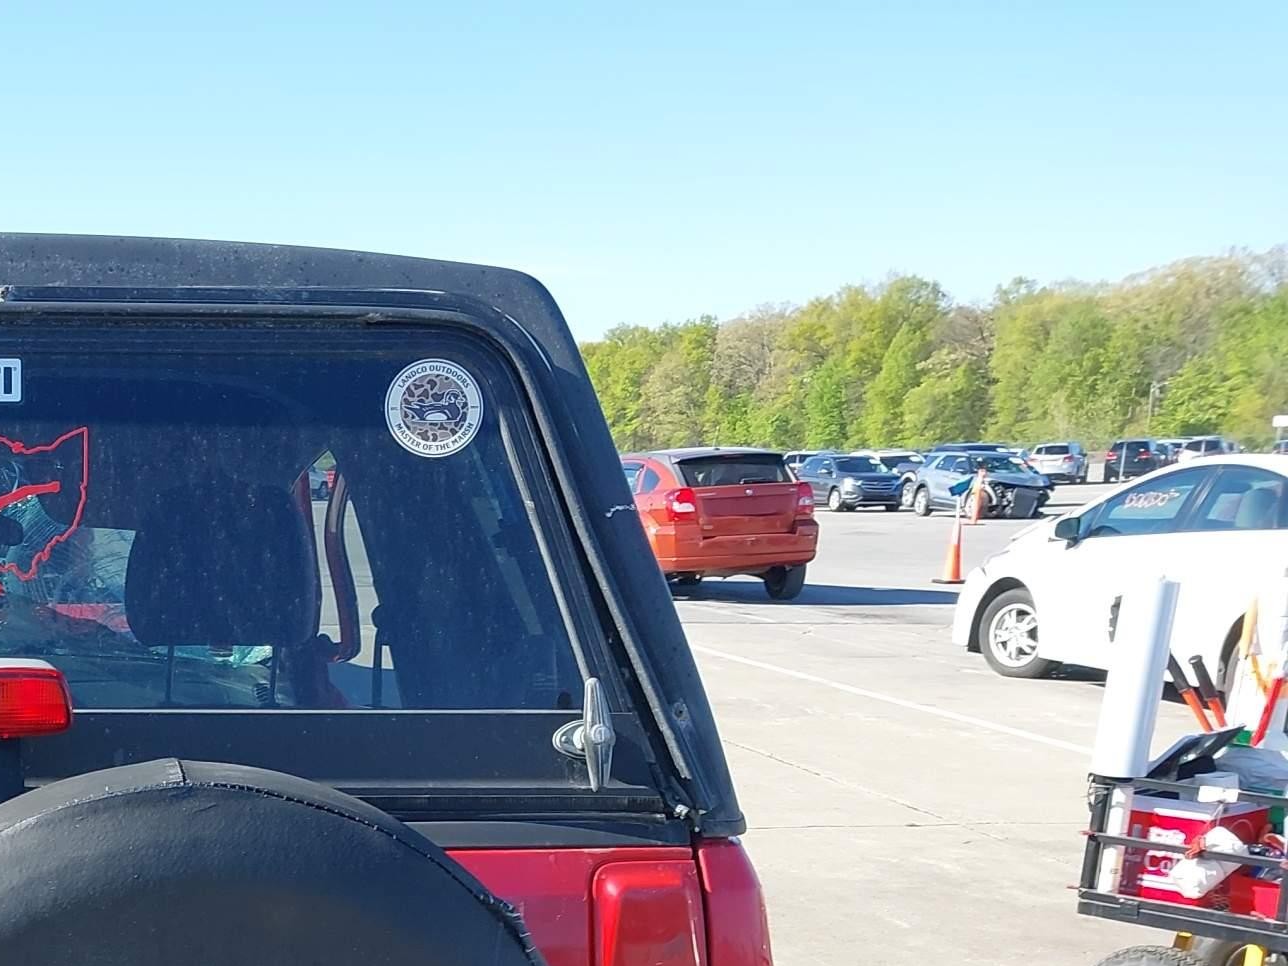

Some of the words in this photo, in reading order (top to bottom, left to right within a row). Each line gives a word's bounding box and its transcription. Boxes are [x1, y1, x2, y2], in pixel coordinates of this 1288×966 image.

[398, 365, 427, 388] LANDCO
[429, 364, 470, 389] OUTDOORS
[395, 423, 420, 449] MASTER
[422, 443, 434, 451] OF
[435, 443, 450, 452] THE
[452, 422, 474, 446] MARSH
